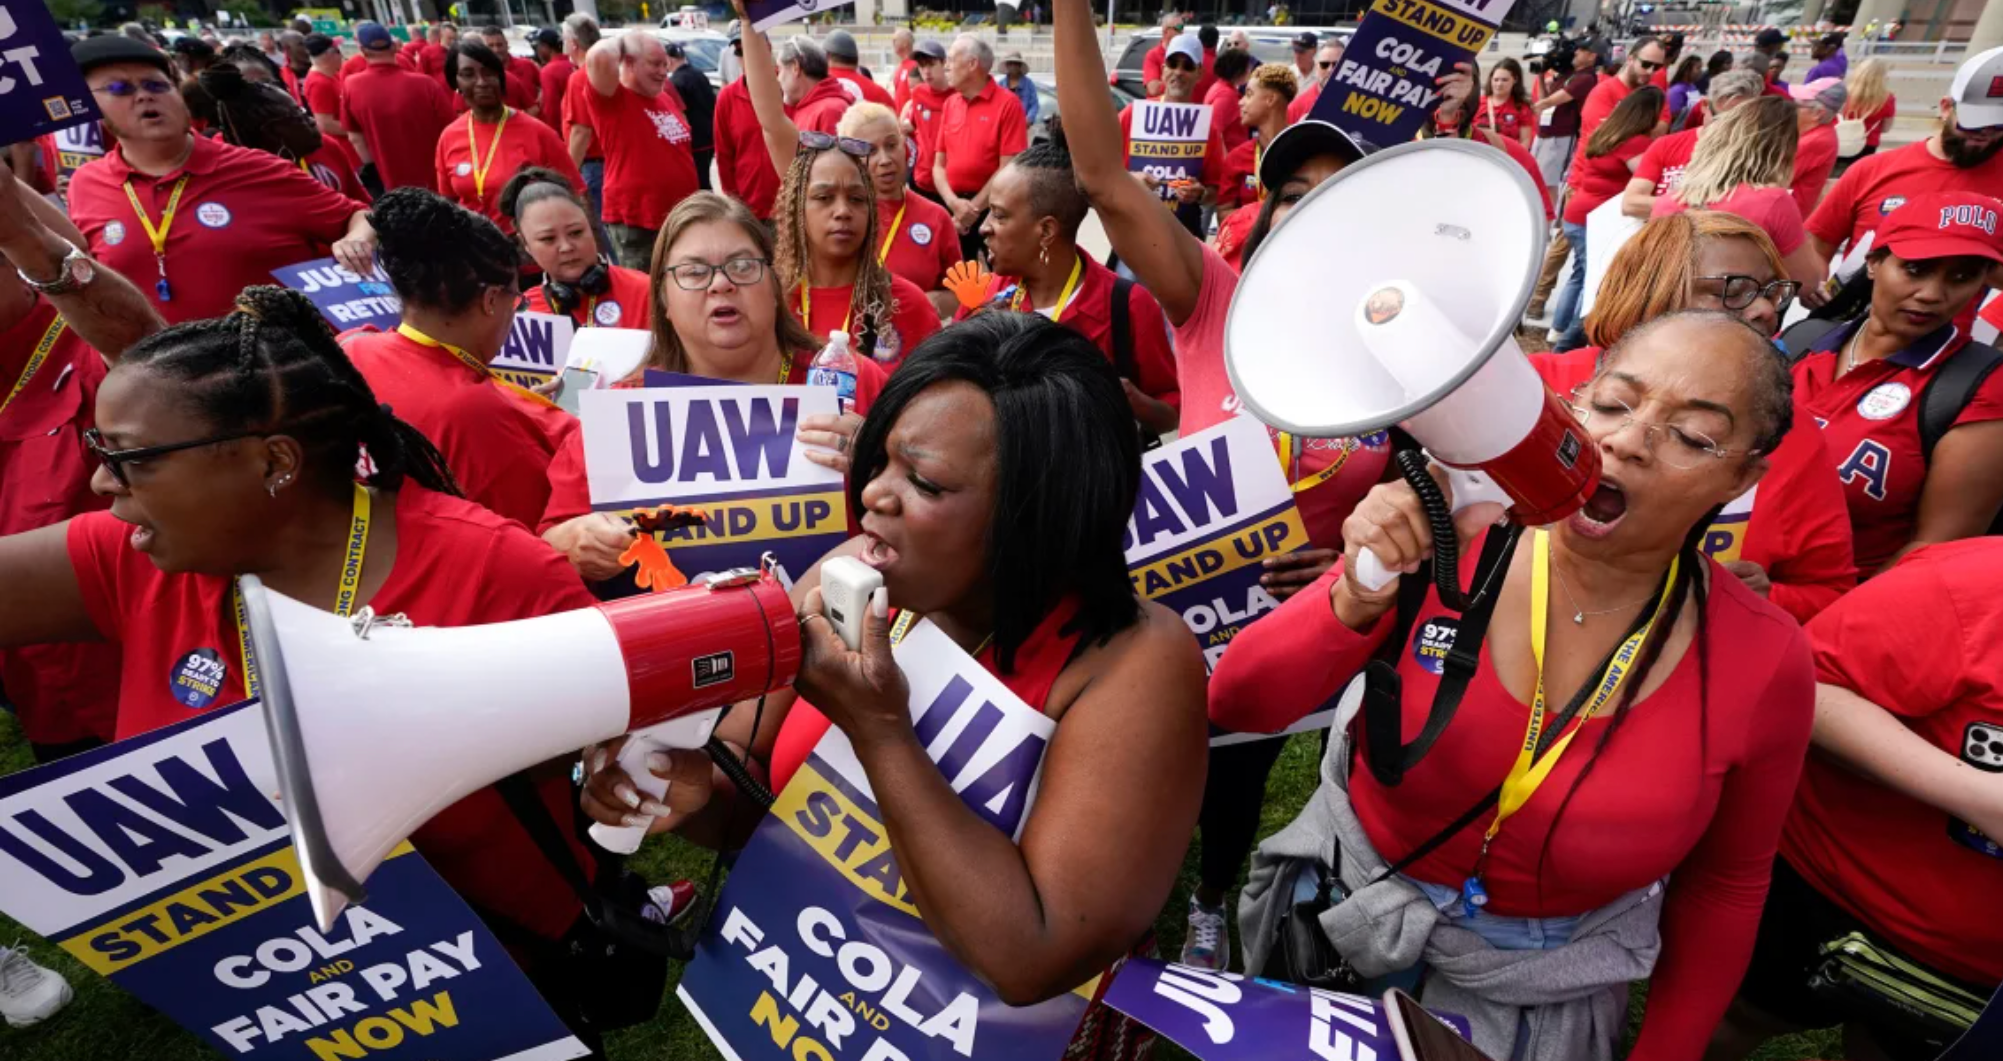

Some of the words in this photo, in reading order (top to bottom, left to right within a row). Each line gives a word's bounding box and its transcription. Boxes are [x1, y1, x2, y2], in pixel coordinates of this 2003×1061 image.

[1383, 0, 1456, 36] STAND
[1457, 24, 1486, 46] UP
[1375, 36, 1443, 77] COLA
[1335, 59, 1393, 97] FAIR
[1390, 77, 1441, 109] PAY
[1144, 105, 1200, 137] UAW
[1342, 91, 1405, 125] NOW
[1133, 143, 1180, 155] STAND
[1184, 145, 1202, 156] UP
[1938, 204, 1998, 236] POLO
[38, 317, 64, 353] CONTRA
[496, 316, 555, 366] AW
[627, 397, 799, 484] UAW
[1122, 434, 1239, 548] AW
[771, 500, 831, 532] UP
[343, 516, 367, 587] CONTRACT
[1232, 520, 1290, 560] UP
[1183, 585, 1281, 635] OLA
[186, 653, 226, 681] 97%
[1421, 638, 1453, 650] READY
[1618, 638, 1641, 665] THE
[177, 675, 217, 698] STRIKE
[1524, 698, 1543, 751] UNITED
[0, 736, 287, 896] UAW
[89, 865, 293, 963] STAND
[213, 904, 404, 989] COLA
[211, 981, 369, 1054] FAIR
[359, 930, 484, 1002] PAY
[309, 959, 354, 984] AND
[720, 905, 856, 1051] FAIR
[796, 906, 980, 1058] COLA
[303, 990, 460, 1061] NOW
[838, 991, 891, 1031] AND
